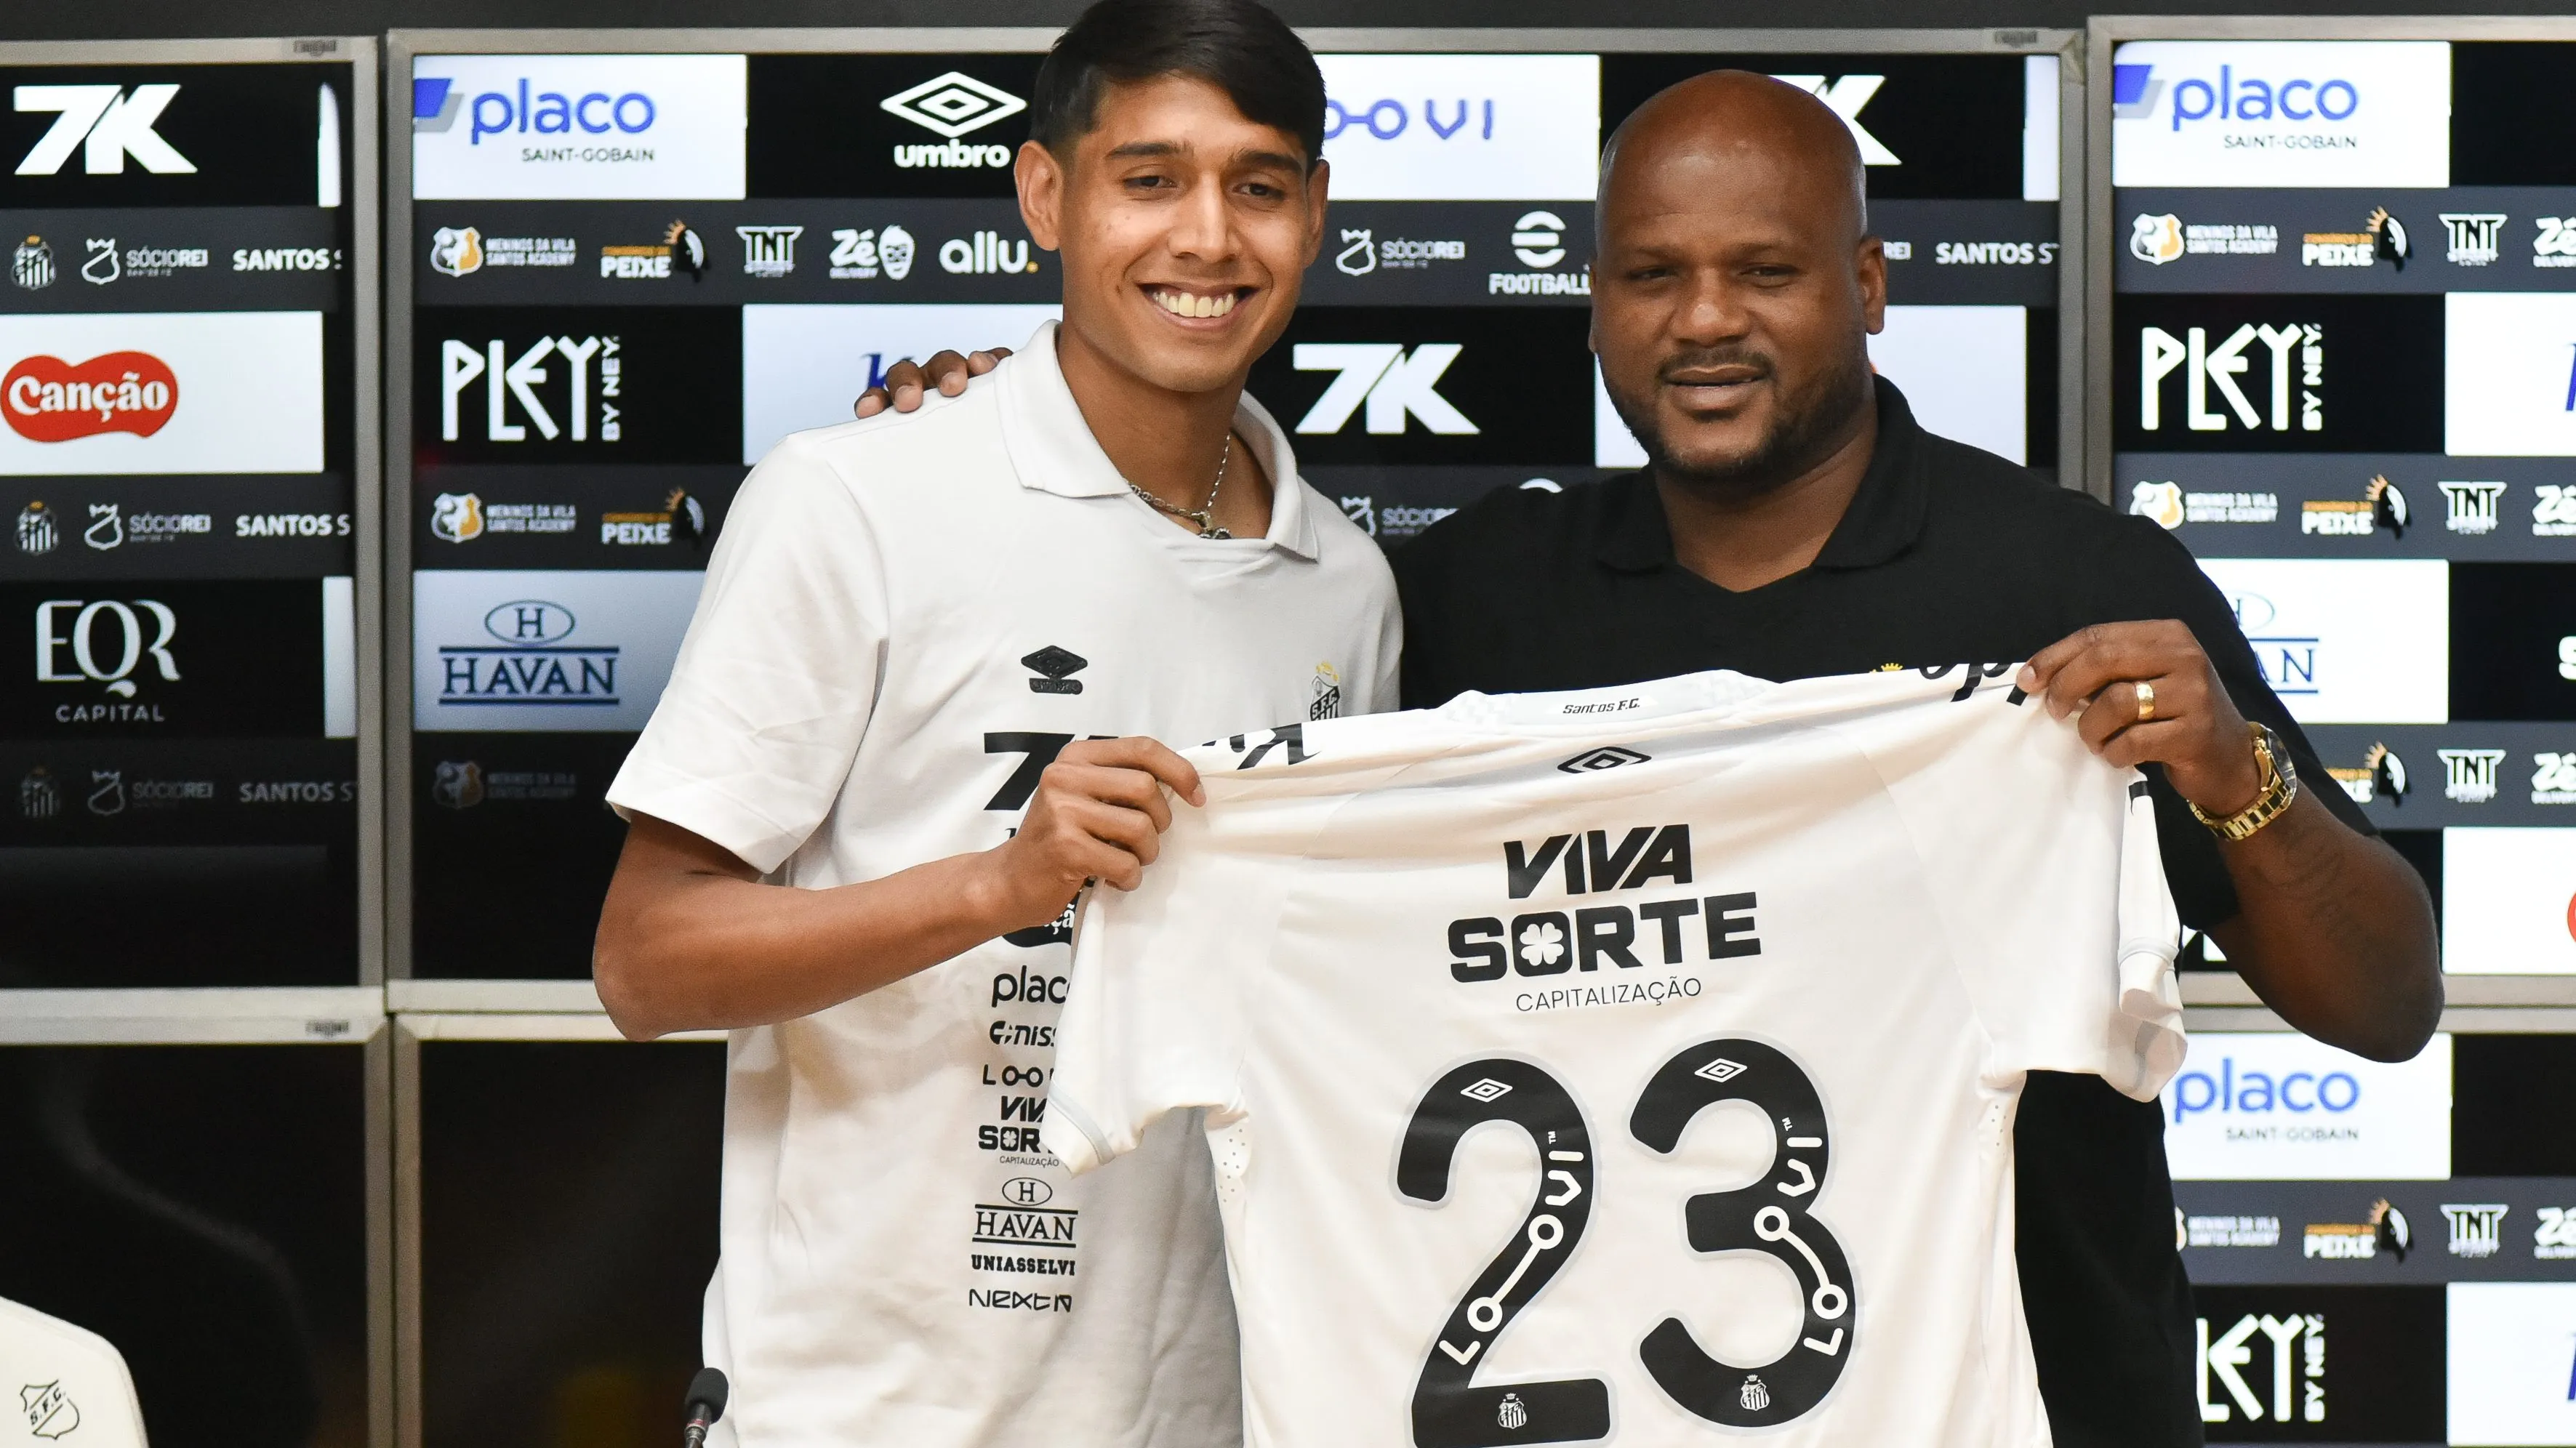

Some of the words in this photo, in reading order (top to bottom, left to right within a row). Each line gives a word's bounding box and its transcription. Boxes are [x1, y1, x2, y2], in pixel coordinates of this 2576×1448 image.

[471, 78, 655, 145] placo
[2172, 65, 2359, 132] placo
[14, 84, 198, 174] 7K
[1323, 99, 1493, 140] OOVI
[1768, 74, 1902, 165] K
[522, 148, 654, 163] SAINT-GOBAIN
[894, 139, 1011, 168] umbro
[2224, 135, 2357, 150] SAINT-GOBAIN
[736, 226, 804, 263] TNT
[829, 228, 879, 268] Zé
[2438, 213, 2508, 251] TNT
[233, 248, 330, 272] SANTOS
[601, 255, 672, 278] PEIXE
[1935, 242, 2035, 265] SANTOS
[2302, 244, 2375, 267] PEIXE
[443, 335, 601, 441] PLEY
[1293, 343, 1482, 435] 7K
[2142, 323, 2303, 430] PLEY
[8, 370, 170, 422] Canção
[2303, 390, 2322, 431] BY
[602, 402, 620, 441] BY
[2438, 481, 2507, 520] TNT
[236, 514, 332, 537] SANTOS
[601, 523, 672, 544] PEIXE
[2302, 512, 2374, 535] PEIXE
[515, 607, 545, 638] H
[36, 600, 182, 698] EQR
[442, 657, 617, 695] HAVAN
[55, 704, 165, 723] CAPITAL
[1562, 704, 1615, 714] Santos
[984, 731, 1119, 811] 7
[2437, 749, 2506, 789] TNT
[239, 781, 335, 803] SANTOS
[1504, 824, 1693, 899] VIVA
[1448, 892, 1762, 984] SORTE
[991, 965, 1070, 1008] plac
[1516, 976, 1702, 1013] CAPITALIZAÇÃO
[1001, 1095, 1048, 1124] VIV
[2174, 1058, 2361, 1125] placo
[978, 1125, 1054, 1154] SOR
[1000, 1155, 1060, 1169] CAPITALIZAÇÃO
[1018, 1181, 1036, 1203] H
[974, 1211, 1076, 1241] HAVAN
[1397, 1038, 1856, 1448] 23
[2440, 1204, 2509, 1245] TNT
[971, 1254, 1075, 1276] UNIASSELVI
[2196, 1314, 2305, 1422] LEY
[2305, 1380, 2324, 1422] BY
